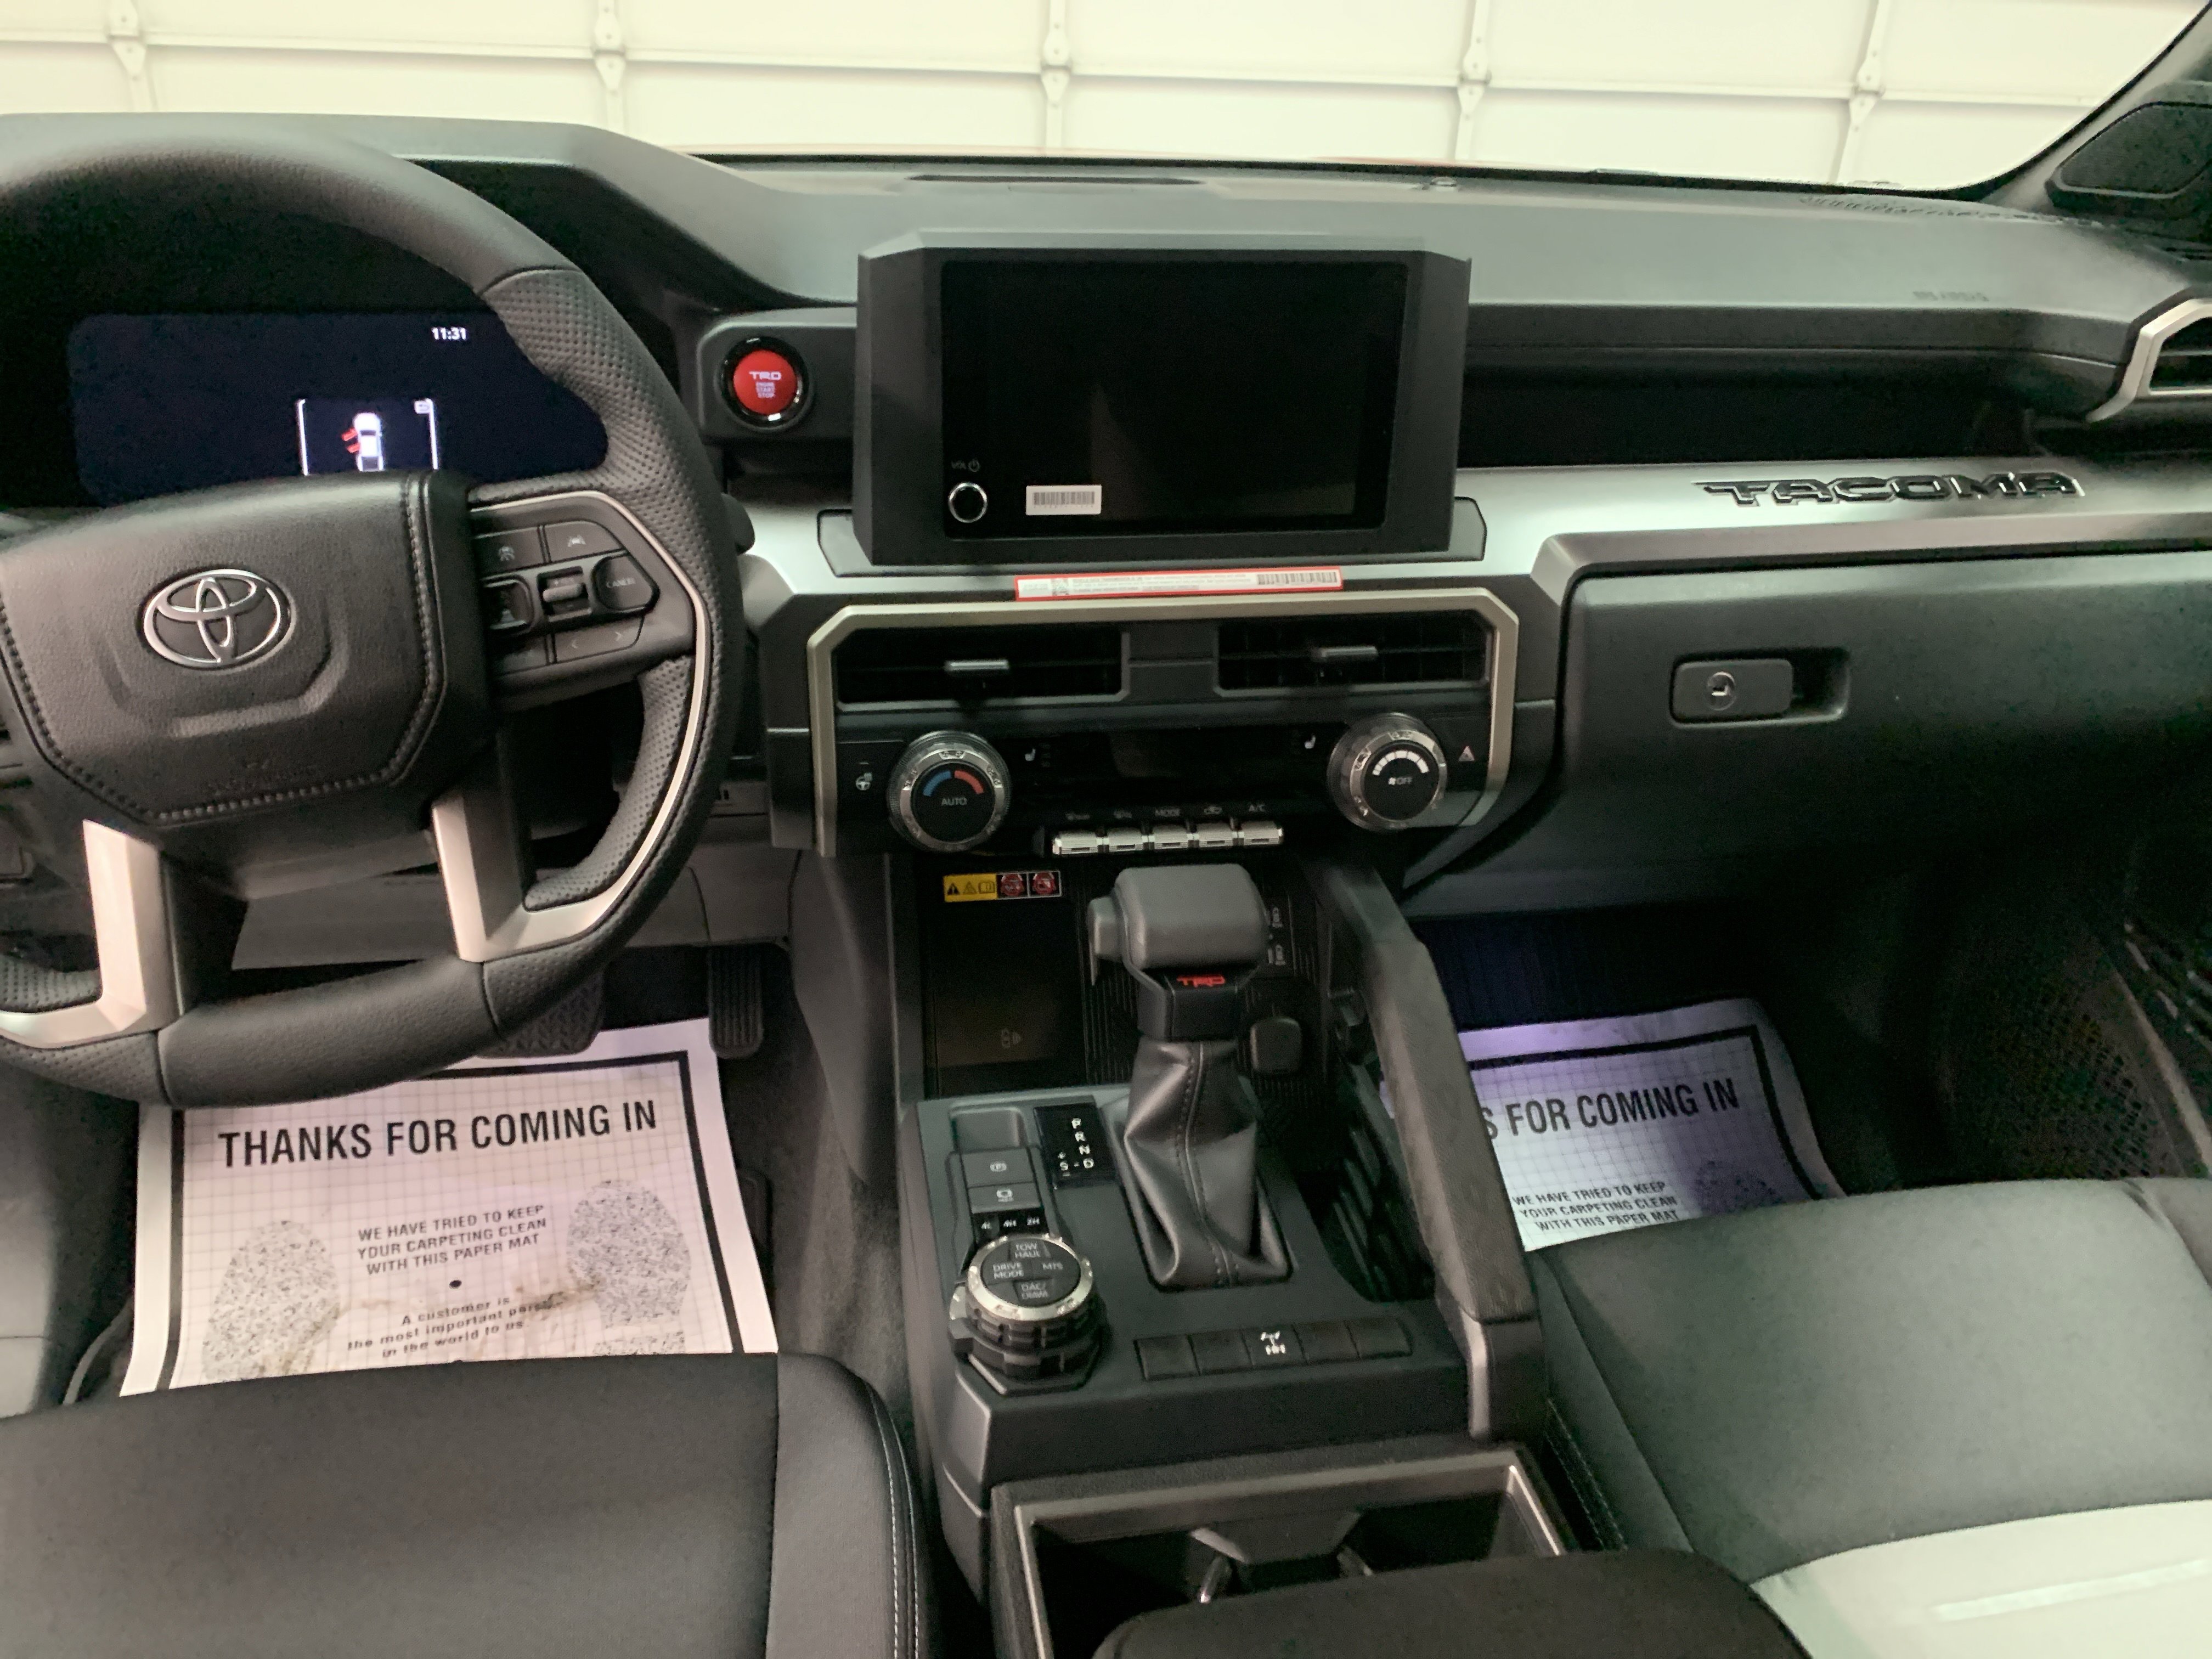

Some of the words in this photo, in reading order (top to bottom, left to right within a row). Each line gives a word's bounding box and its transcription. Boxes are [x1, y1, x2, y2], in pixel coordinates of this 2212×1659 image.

[431, 326, 467, 340] 11:31
[749, 371, 782, 380] TRD
[1692, 472, 2085, 506] TACOMA
[941, 797, 968, 806] AUTO
[1176, 973, 1226, 987] TRD
[1506, 1099, 1571, 1137] FOR
[1577, 1084, 1698, 1127] COMING
[1703, 1078, 1739, 1111] IN
[1071, 1118, 1081, 1128] P
[218, 1123, 372, 1168] THANKS
[387, 1119, 457, 1156] FOR
[471, 1105, 610, 1149] COMING
[623, 1099, 656, 1132] IN
[1075, 1131, 1086, 1142] R
[1079, 1144, 1091, 1155] N
[1511, 1194, 1534, 1206] WE
[1536, 1191, 1572, 1204] HAVE
[1572, 1188, 1612, 1201] TRIED
[1613, 1184, 1633, 1196] TO
[1634, 1181, 1666, 1194] KEEP
[1519, 1207, 1558, 1218] YOUR
[1559, 1199, 1634, 1216] CARPETING
[1634, 1195, 1678, 1210] CLEAN
[358, 1227, 382, 1242] WE
[387, 1221, 427, 1238] HAVE
[433, 1214, 477, 1232] TRIED
[483, 1211, 502, 1223] TO
[507, 1204, 544, 1220] KEEP
[1534, 1218, 1572, 1232] WITH
[1573, 1215, 1605, 1227] THIS
[1606, 1210, 1650, 1226] PAPER
[1650, 1209, 1680, 1221] MAT
[357, 1243, 401, 1260] YOUR
[406, 1228, 494, 1253] CARPETING
[498, 1217, 547, 1238] CLEAN
[1015, 1242, 1038, 1251] TOW
[366, 1258, 407, 1276] WITH
[413, 1251, 449, 1268] THIS
[453, 1242, 503, 1261] PAPER
[508, 1233, 540, 1250] MAT
[1015, 1248, 1041, 1259] HAUL
[992, 1262, 1023, 1273] DRIVE
[994, 1269, 1024, 1280] MODE
[1042, 1261, 1063, 1271] MTS
[401, 1316, 411, 1327] A
[417, 1302, 491, 1323] customer
[497, 1296, 511, 1306] is
[347, 1338, 374, 1351] the
[380, 1327, 420, 1345] most
[426, 1310, 503, 1335] important
[382, 1348, 397, 1358] in
[403, 1341, 430, 1354] the
[435, 1330, 480, 1347] world
[485, 1324, 500, 1336] to
[506, 1319, 524, 1330] us
